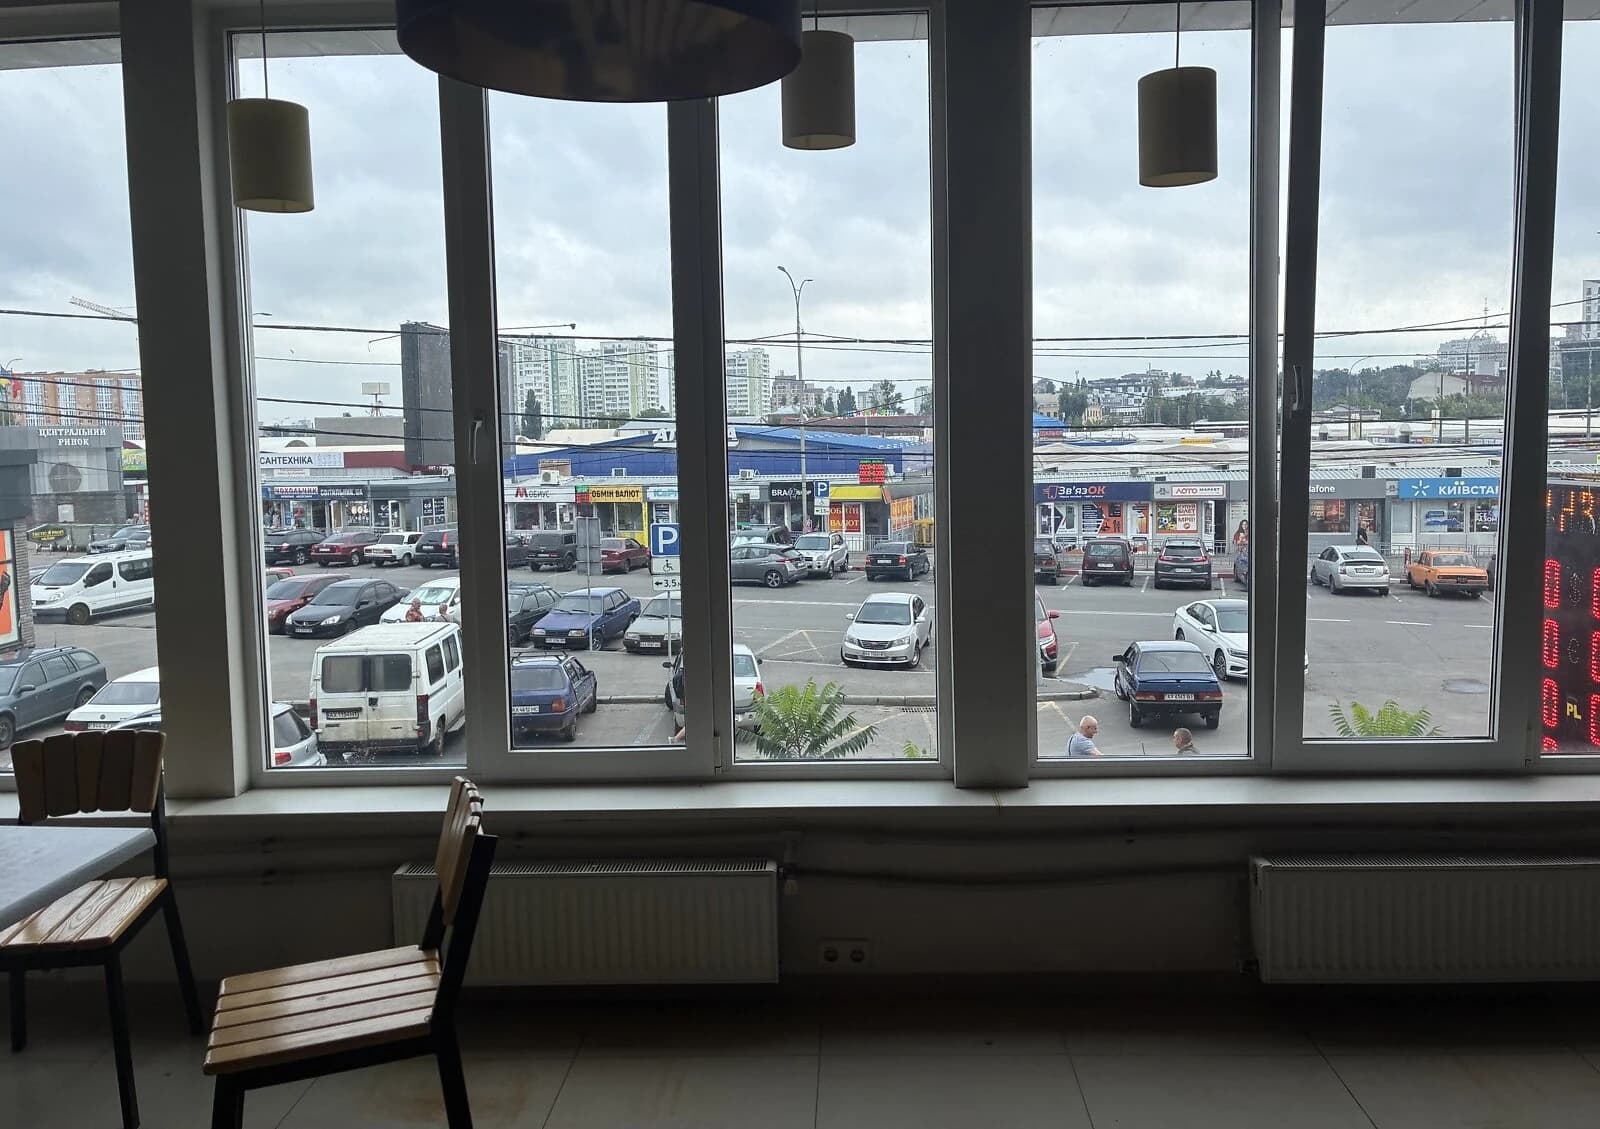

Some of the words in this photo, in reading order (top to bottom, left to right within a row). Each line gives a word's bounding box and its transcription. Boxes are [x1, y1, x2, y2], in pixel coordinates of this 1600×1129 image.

[39, 427, 106, 437] ЦЕНТРАЛЬНИЙ
[58, 438, 89, 446] РИНОК
[260, 456, 313, 465] САНТЕХНІКА
[591, 490, 614, 498] ОБМІН
[615, 490, 640, 498] ВАЛЮТ
[817, 482, 827, 496] P
[658, 526, 678, 554] P
[1566, 702, 1582, 720] PL
